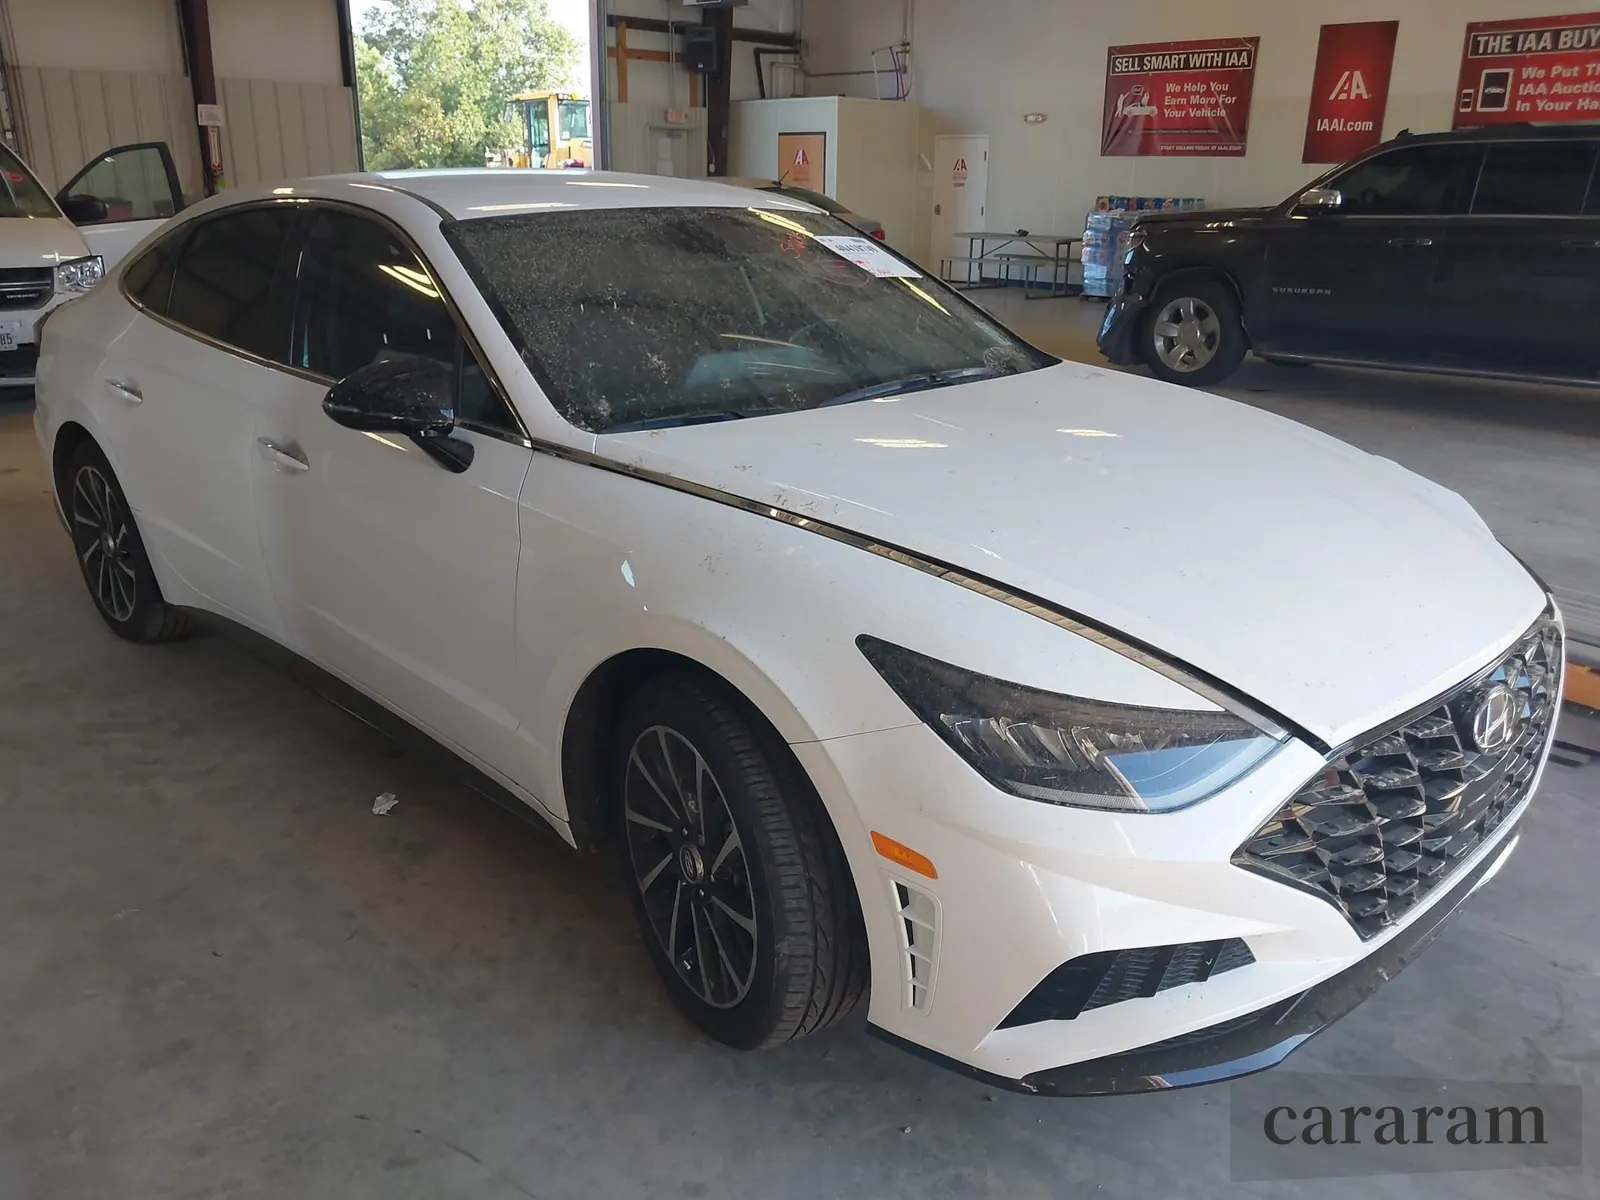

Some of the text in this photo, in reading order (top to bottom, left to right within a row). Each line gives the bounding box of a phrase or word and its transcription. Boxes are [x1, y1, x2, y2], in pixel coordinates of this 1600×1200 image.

[1477, 34, 1513, 54] THE
[1516, 32, 1552, 52] IAA
[1115, 51, 1248, 72] SELL SMART WITH IAA
[1522, 66, 1545, 79] We
[1550, 65, 1579, 78] Put
[1166, 82, 1229, 94] We Help You
[1518, 83, 1547, 96] IAA
[1164, 94, 1237, 105] Earn More For
[1516, 100, 1530, 112] In
[1536, 100, 1572, 111] Your
[1164, 107, 1226, 117] Your Vehicle
[1317, 118, 1373, 132] IAAI.com
